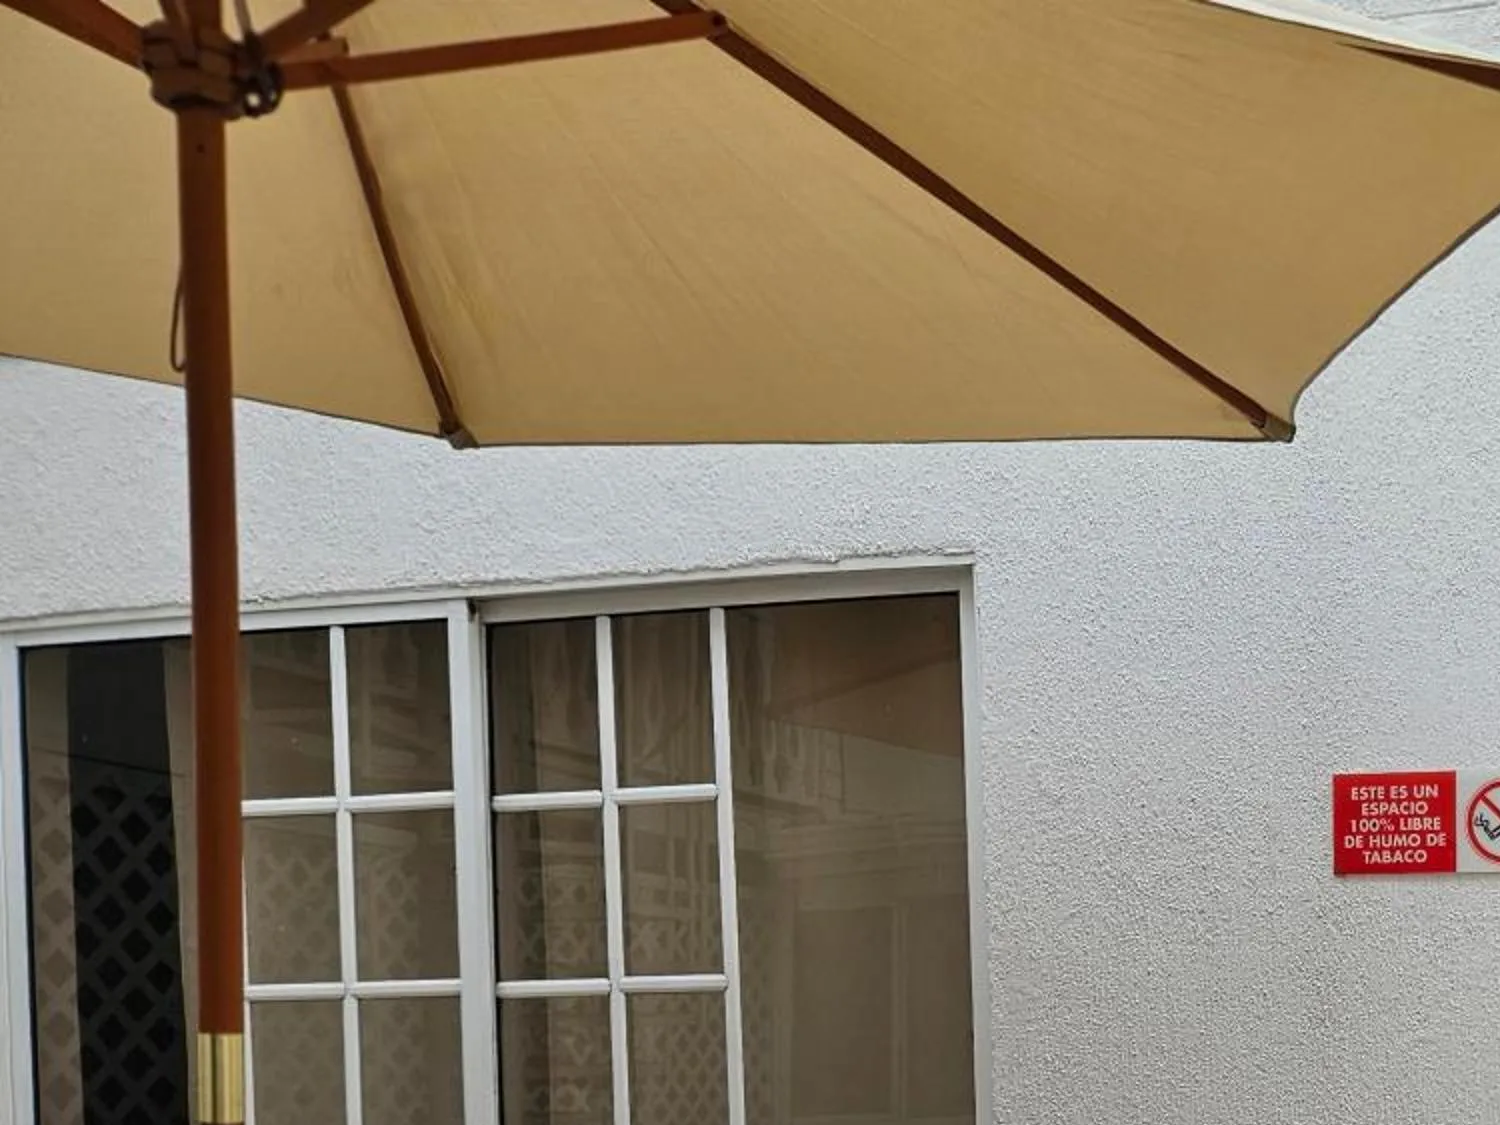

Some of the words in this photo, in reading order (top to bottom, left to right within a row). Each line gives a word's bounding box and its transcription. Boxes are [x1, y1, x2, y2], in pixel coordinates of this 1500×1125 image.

[1351, 786, 1385, 800] ESTE
[1390, 785, 1408, 799] ES
[1414, 784, 1439, 799] UN
[1361, 801, 1428, 816] ESPACIO
[1351, 818, 1395, 833] 100%
[1400, 816, 1441, 831] LIBRE
[1345, 834, 1364, 848] DE
[1369, 833, 1421, 848] HUMO
[1426, 831, 1447, 847] DE
[1362, 849, 1428, 864] TABACO
